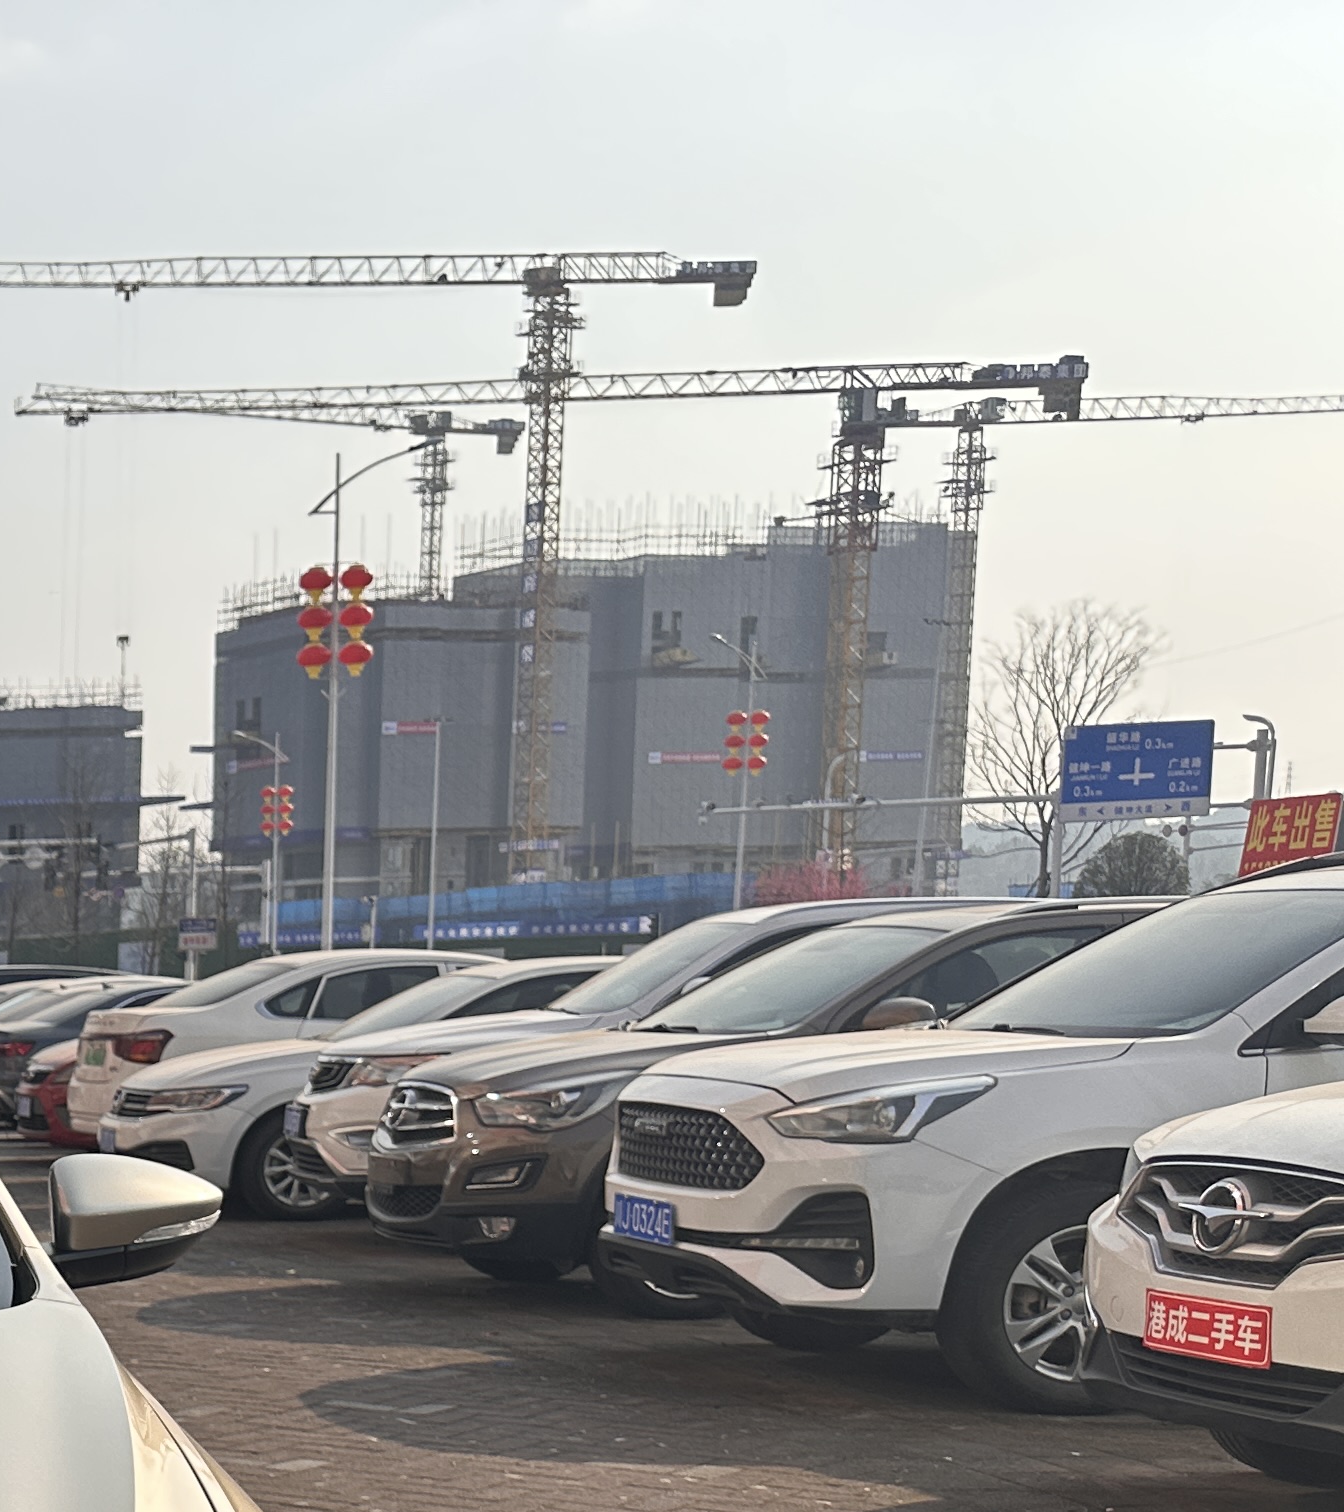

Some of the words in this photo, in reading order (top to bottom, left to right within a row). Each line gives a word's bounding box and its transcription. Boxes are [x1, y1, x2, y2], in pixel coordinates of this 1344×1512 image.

[1246, 799, 1337, 852] 此车出售
[1147, 1300, 1263, 1356] 港成二手车
